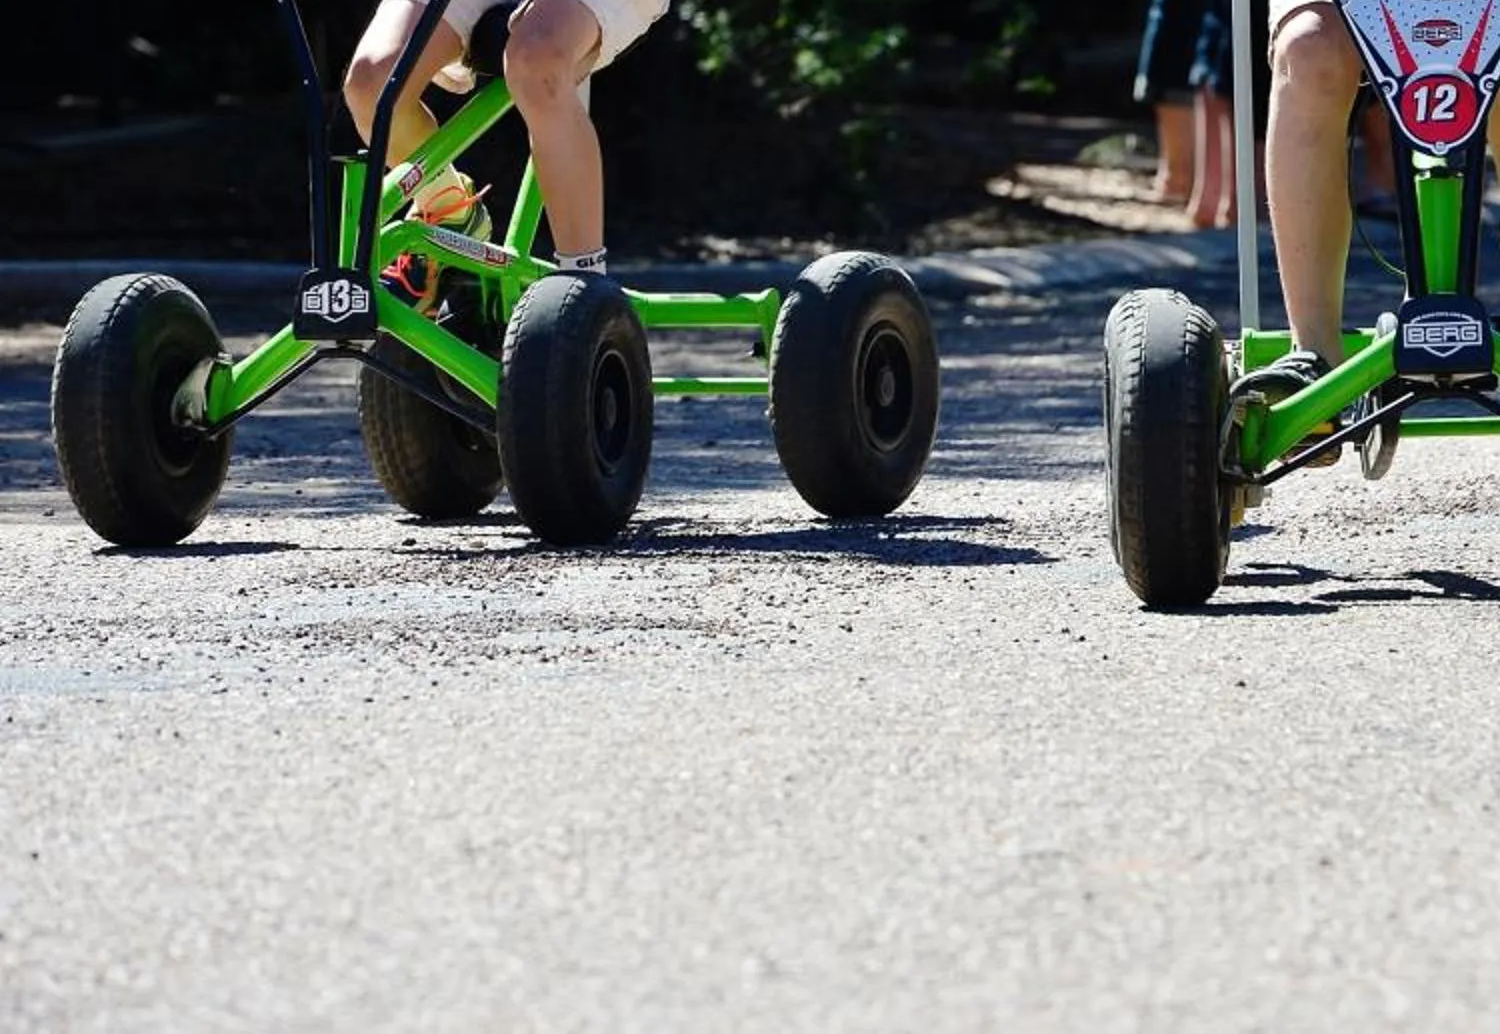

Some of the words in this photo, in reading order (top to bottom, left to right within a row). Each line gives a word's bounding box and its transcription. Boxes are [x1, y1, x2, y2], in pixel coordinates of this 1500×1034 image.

[1413, 83, 1458, 123] 12
[317, 279, 351, 315] 13
[1407, 325, 1477, 343] BERG
